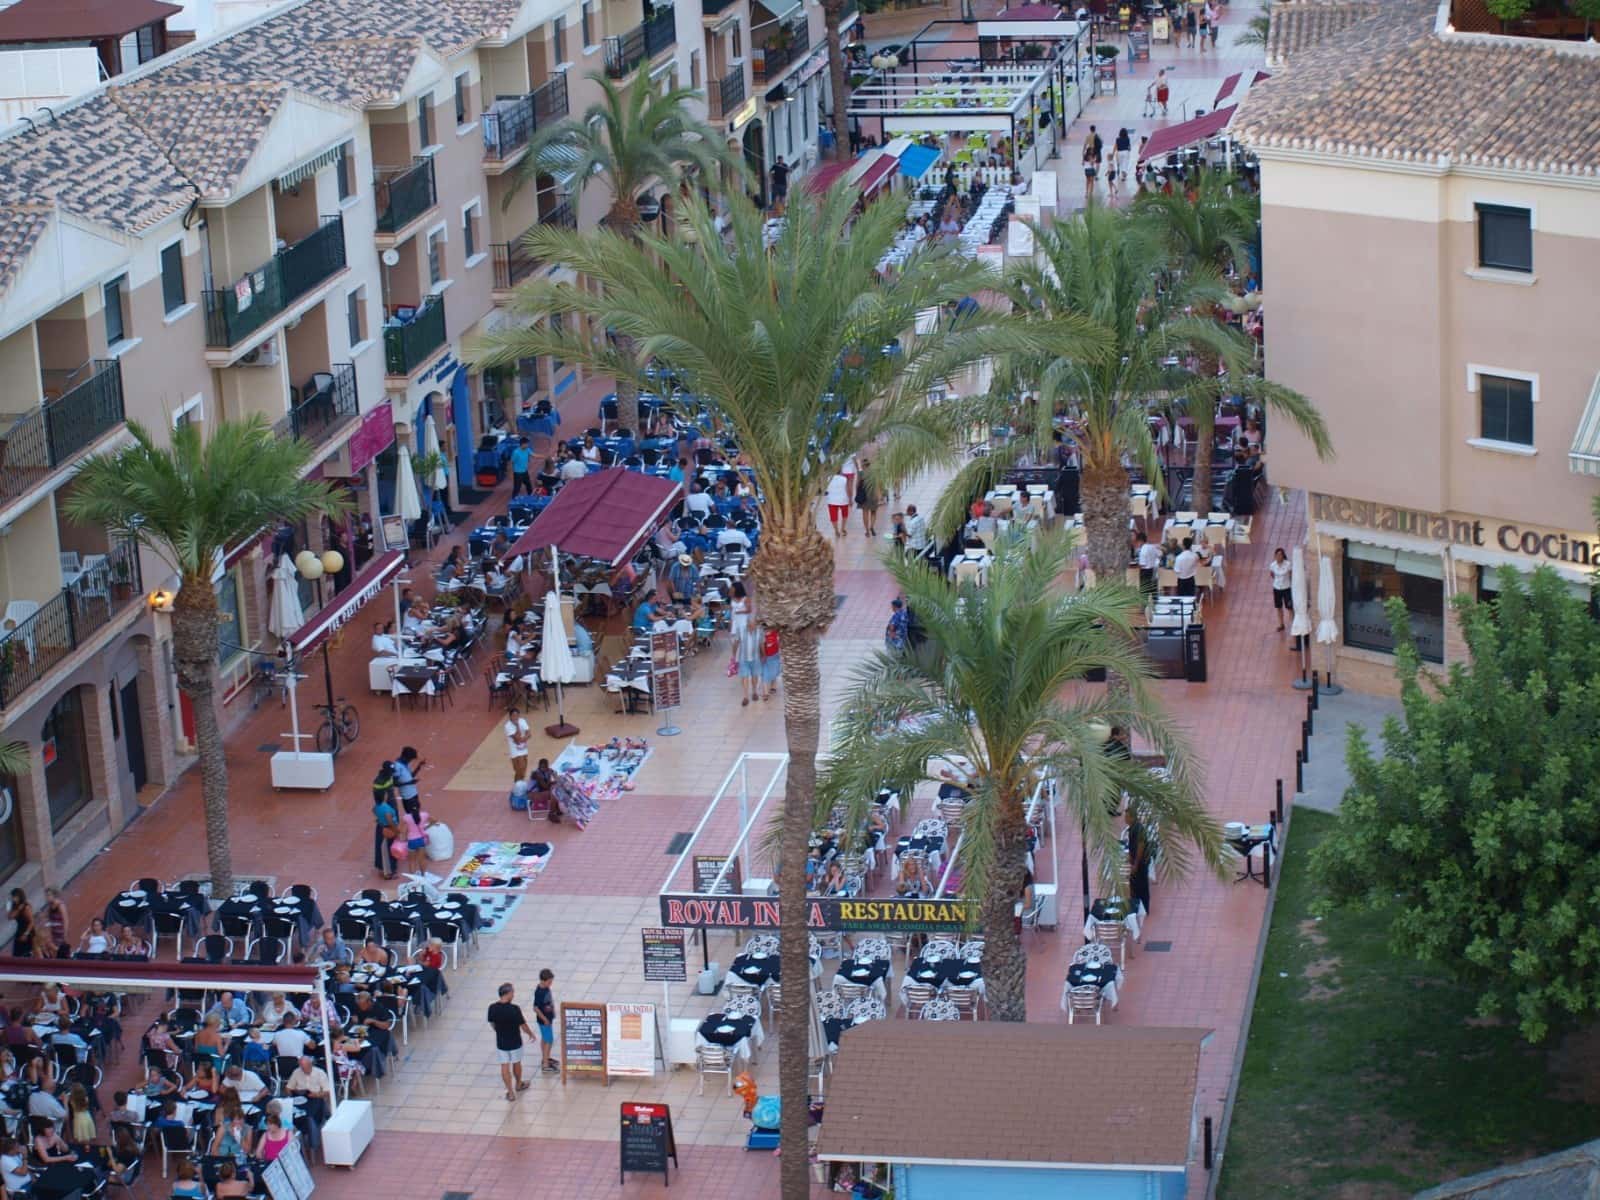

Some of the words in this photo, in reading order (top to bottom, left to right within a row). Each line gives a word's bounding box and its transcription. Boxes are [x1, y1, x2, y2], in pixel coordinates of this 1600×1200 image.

[1312, 492, 1485, 546] Restaurant
[668, 899, 750, 927] ROYAL
[753, 902, 826, 928] INA
